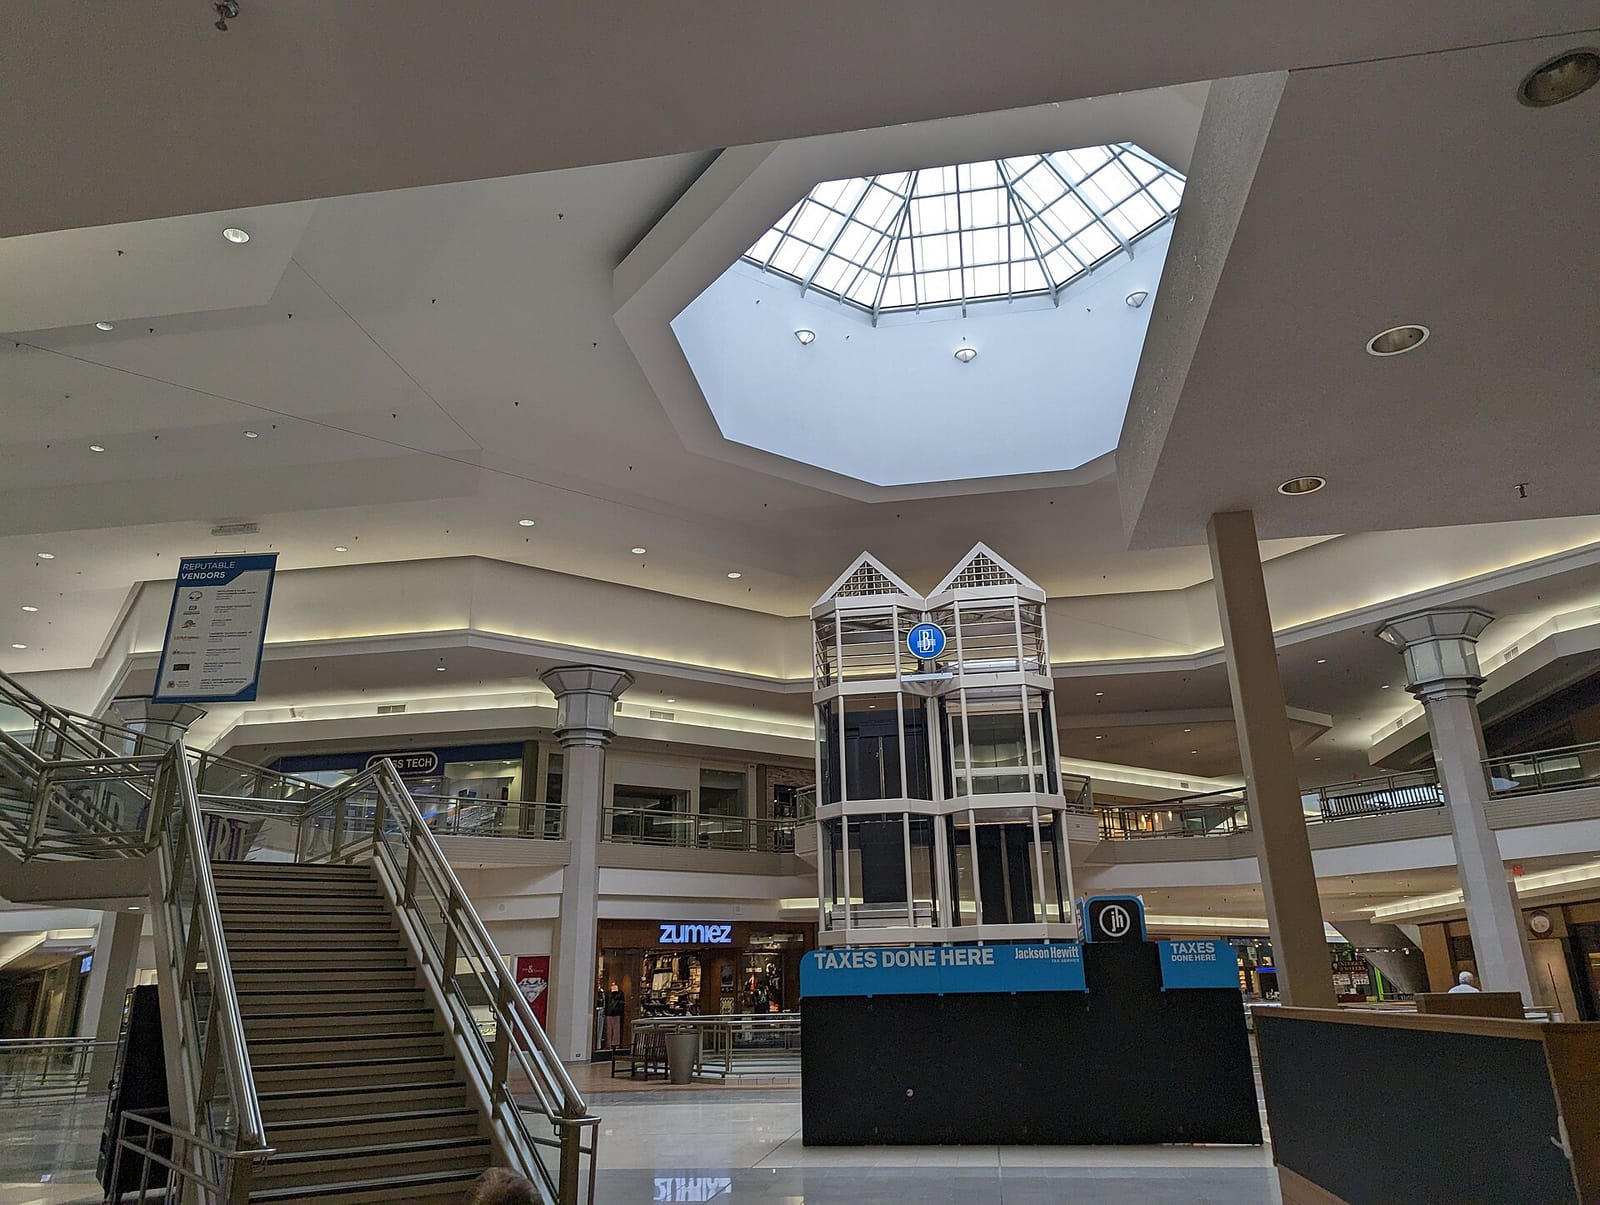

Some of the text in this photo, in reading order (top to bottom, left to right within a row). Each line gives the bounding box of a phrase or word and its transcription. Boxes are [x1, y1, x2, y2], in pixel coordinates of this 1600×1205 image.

[182, 561, 237, 571] REPUTABLE
[181, 571, 226, 580] VENDORS
[406, 757, 432, 768] TECH
[1110, 906, 1124, 932] jh
[659, 924, 732, 943] zumiez
[1015, 946, 1080, 959] Jackson Hewitt
[1170, 942, 1215, 954] TAXES
[814, 948, 995, 969] TAXES DONE HERE
[1171, 953, 1217, 962] DONE HERE
